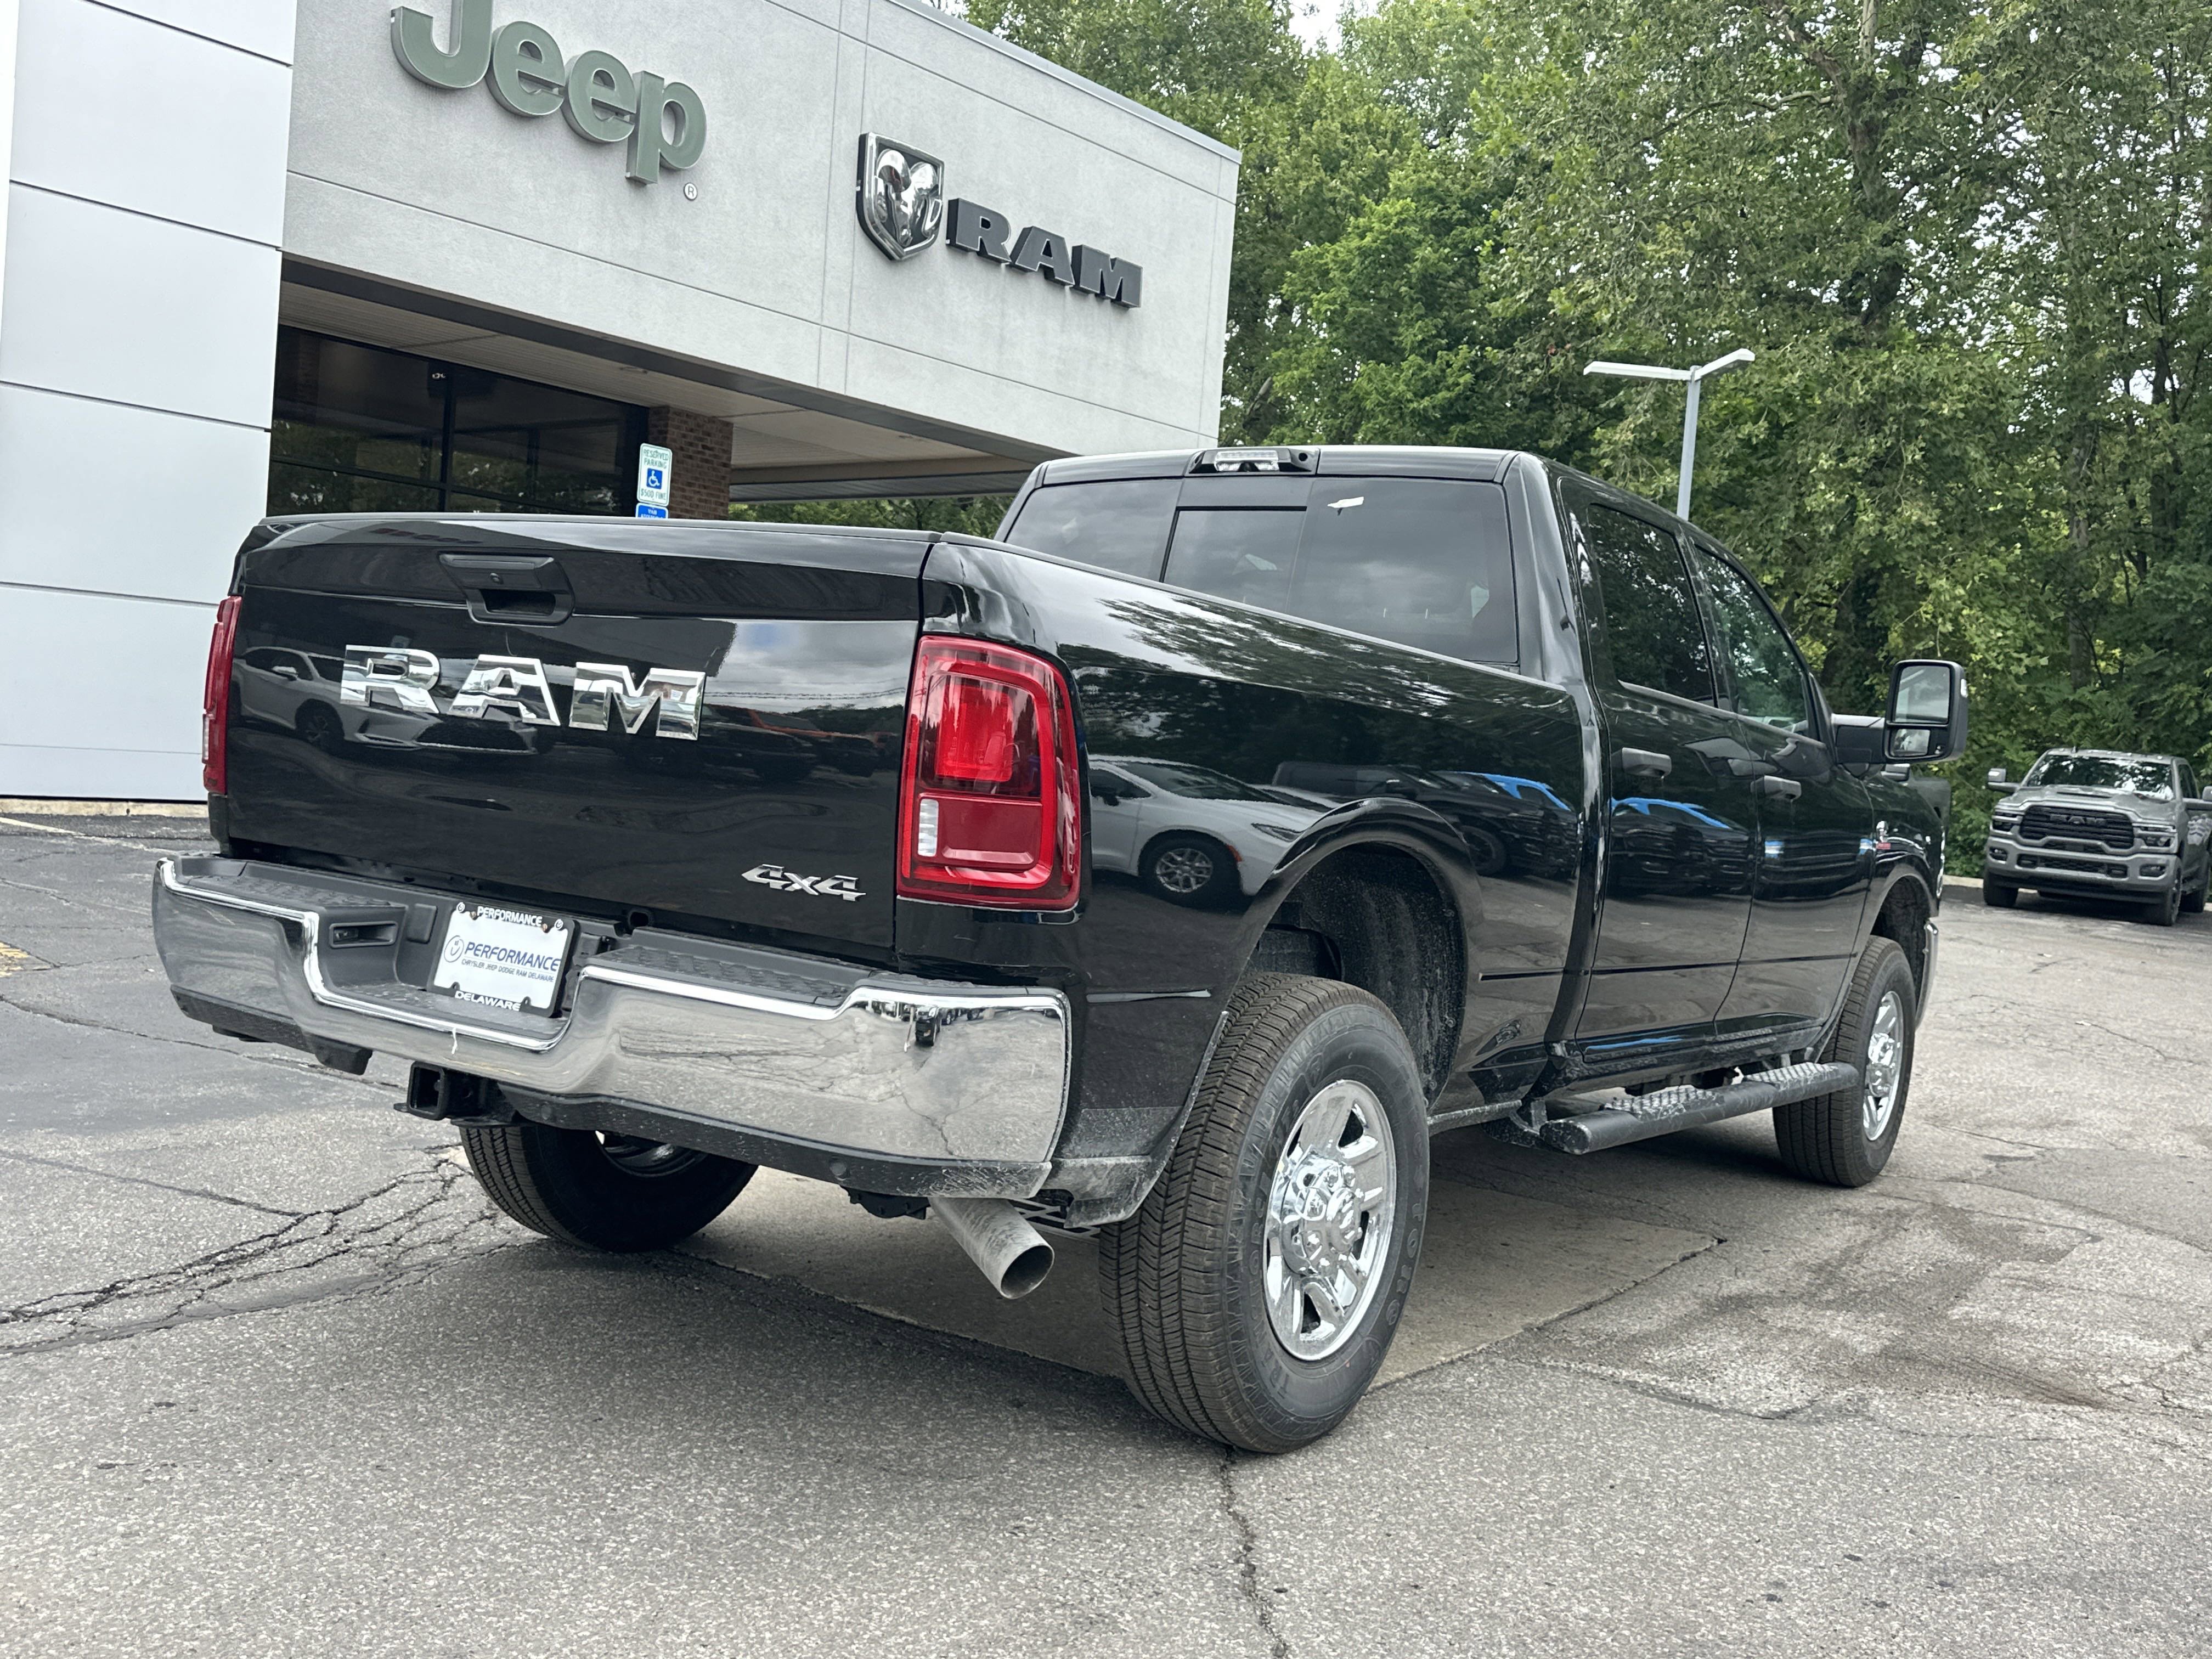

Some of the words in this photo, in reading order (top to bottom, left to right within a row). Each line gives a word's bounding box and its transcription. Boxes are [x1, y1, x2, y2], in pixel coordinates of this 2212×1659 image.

[391, 0, 707, 185] Jeep
[946, 198, 1143, 309] RAM
[643, 449, 668, 461] RESERVED
[644, 458, 667, 469] PARKING
[640, 488, 654, 498] $500
[340, 644, 706, 741] RAM
[477, 905, 543, 927] PERFORMANCE
[464, 941, 561, 972] PERFORMANCE
[461, 958, 486, 969] CHRYSLER
[498, 966, 516, 975] DODGE
[516, 969, 527, 978] RAM
[528, 972, 554, 983] DELAWARE
[454, 990, 521, 1012] DELAWARE
